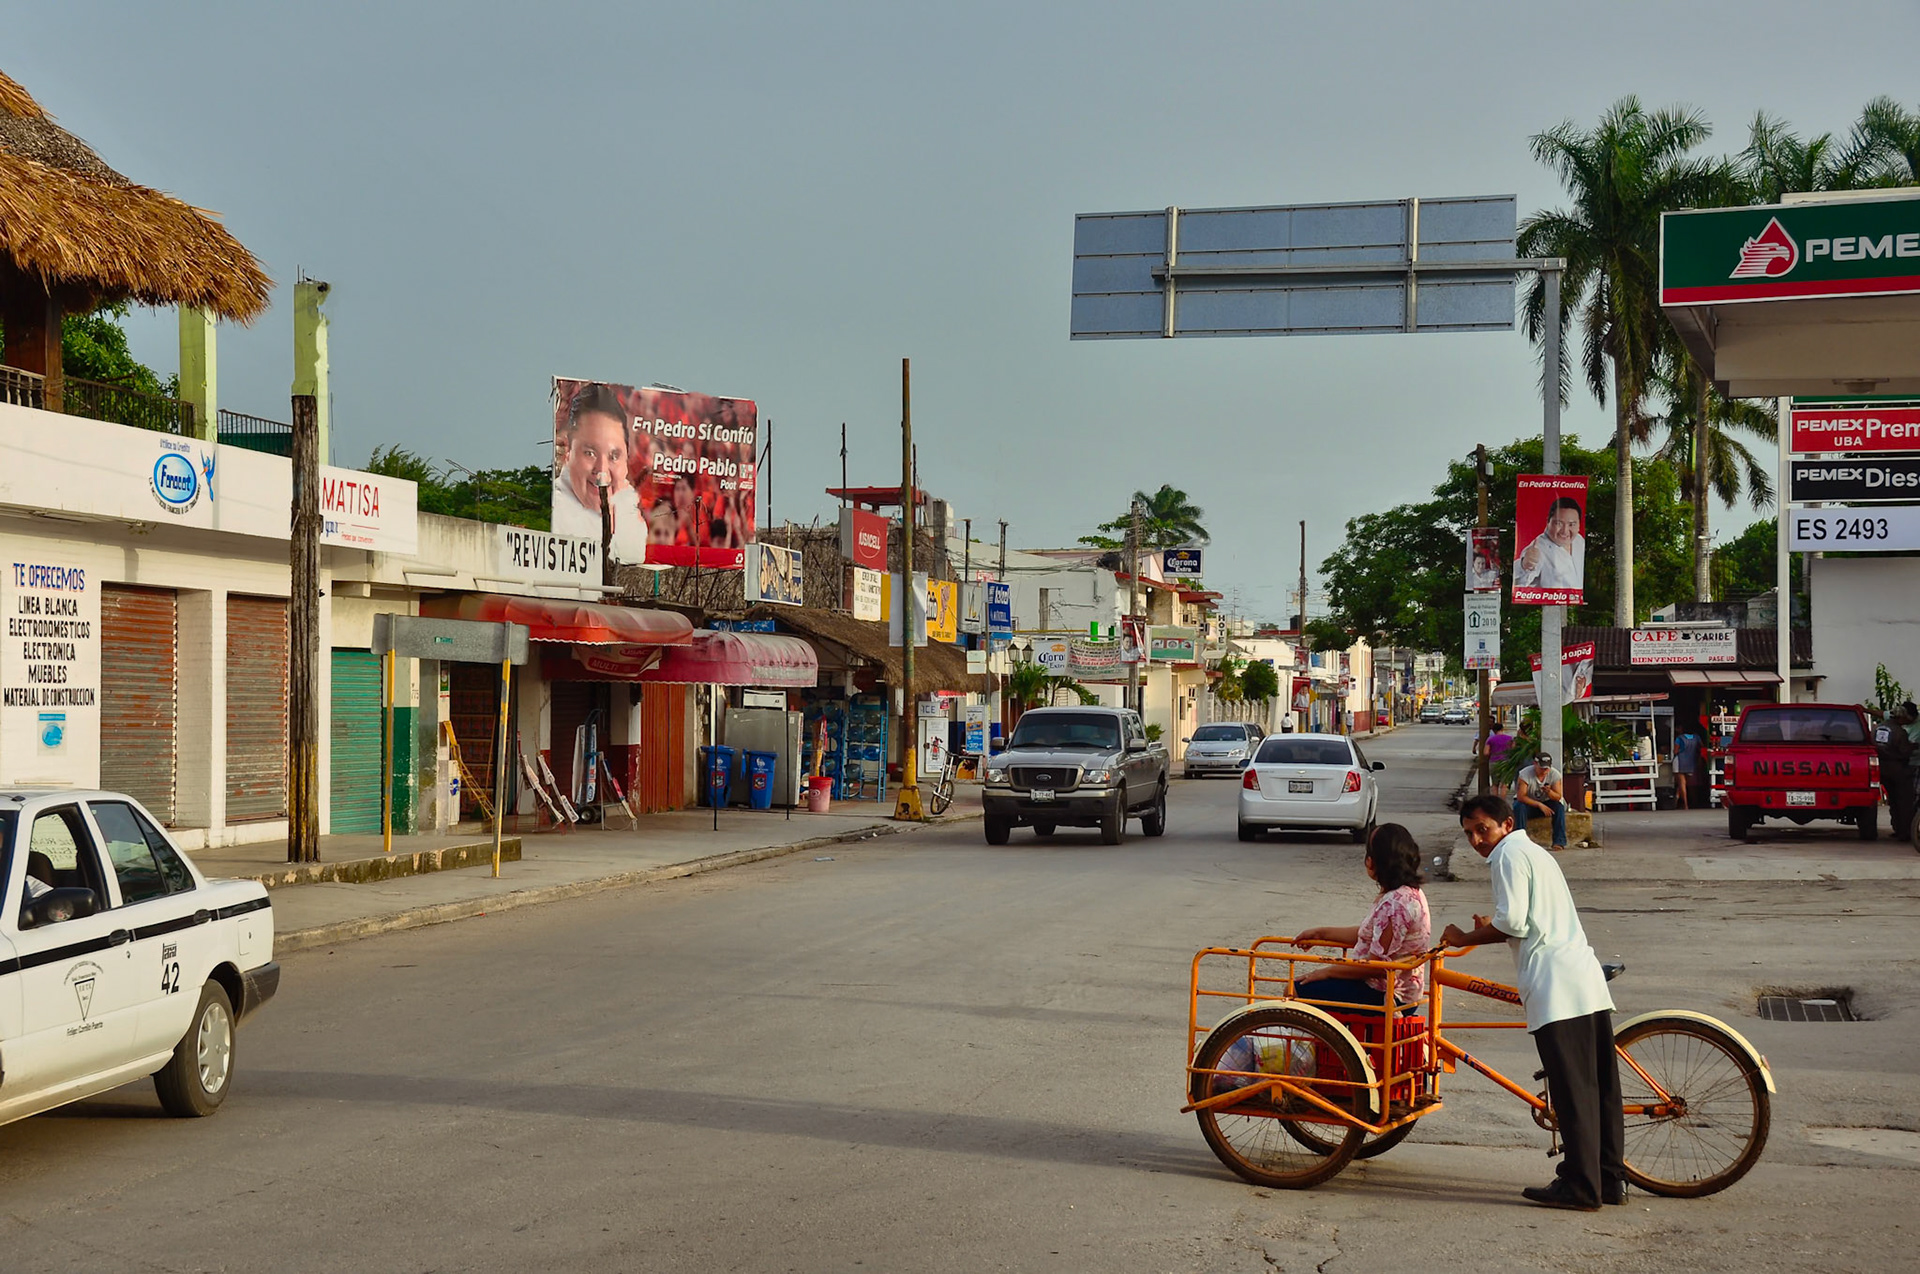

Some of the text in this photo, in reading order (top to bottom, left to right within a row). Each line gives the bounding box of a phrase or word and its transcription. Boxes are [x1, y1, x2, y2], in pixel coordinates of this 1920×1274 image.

[633, 416, 754, 445] En Pedro Sí Confío
[1797, 419, 1863, 432] PEMEX
[1834, 436, 1863, 446] UBA
[653, 453, 697, 474] Pedro
[699, 457, 737, 477] Pablo
[720, 480, 737, 490] Poot
[1529, 480, 1551, 488] Pedro
[1796, 467, 1920, 487] PEMEX Dies
[322, 477, 380, 518] MATISA
[1797, 518, 1889, 540] ES 2493
[1167, 558, 1198, 567] Corona
[13, 563, 85, 592] TE OFRECEMOS
[1515, 591, 1541, 600] Pedro
[1542, 592, 1567, 601] Pablo
[19, 596, 78, 616] LINEA BLANCA
[9, 618, 90, 639] ELECTRODOMESTICOS
[1482, 618, 1497, 627] 2010
[1632, 631, 1678, 642] CAFE
[24, 642, 75, 661] ELECTRONICA
[28, 665, 67, 684] MUEBLES
[4, 687, 40, 707] MATERIAL
[1753, 761, 1851, 776] NISSAN
[161, 962, 180, 995] 42
